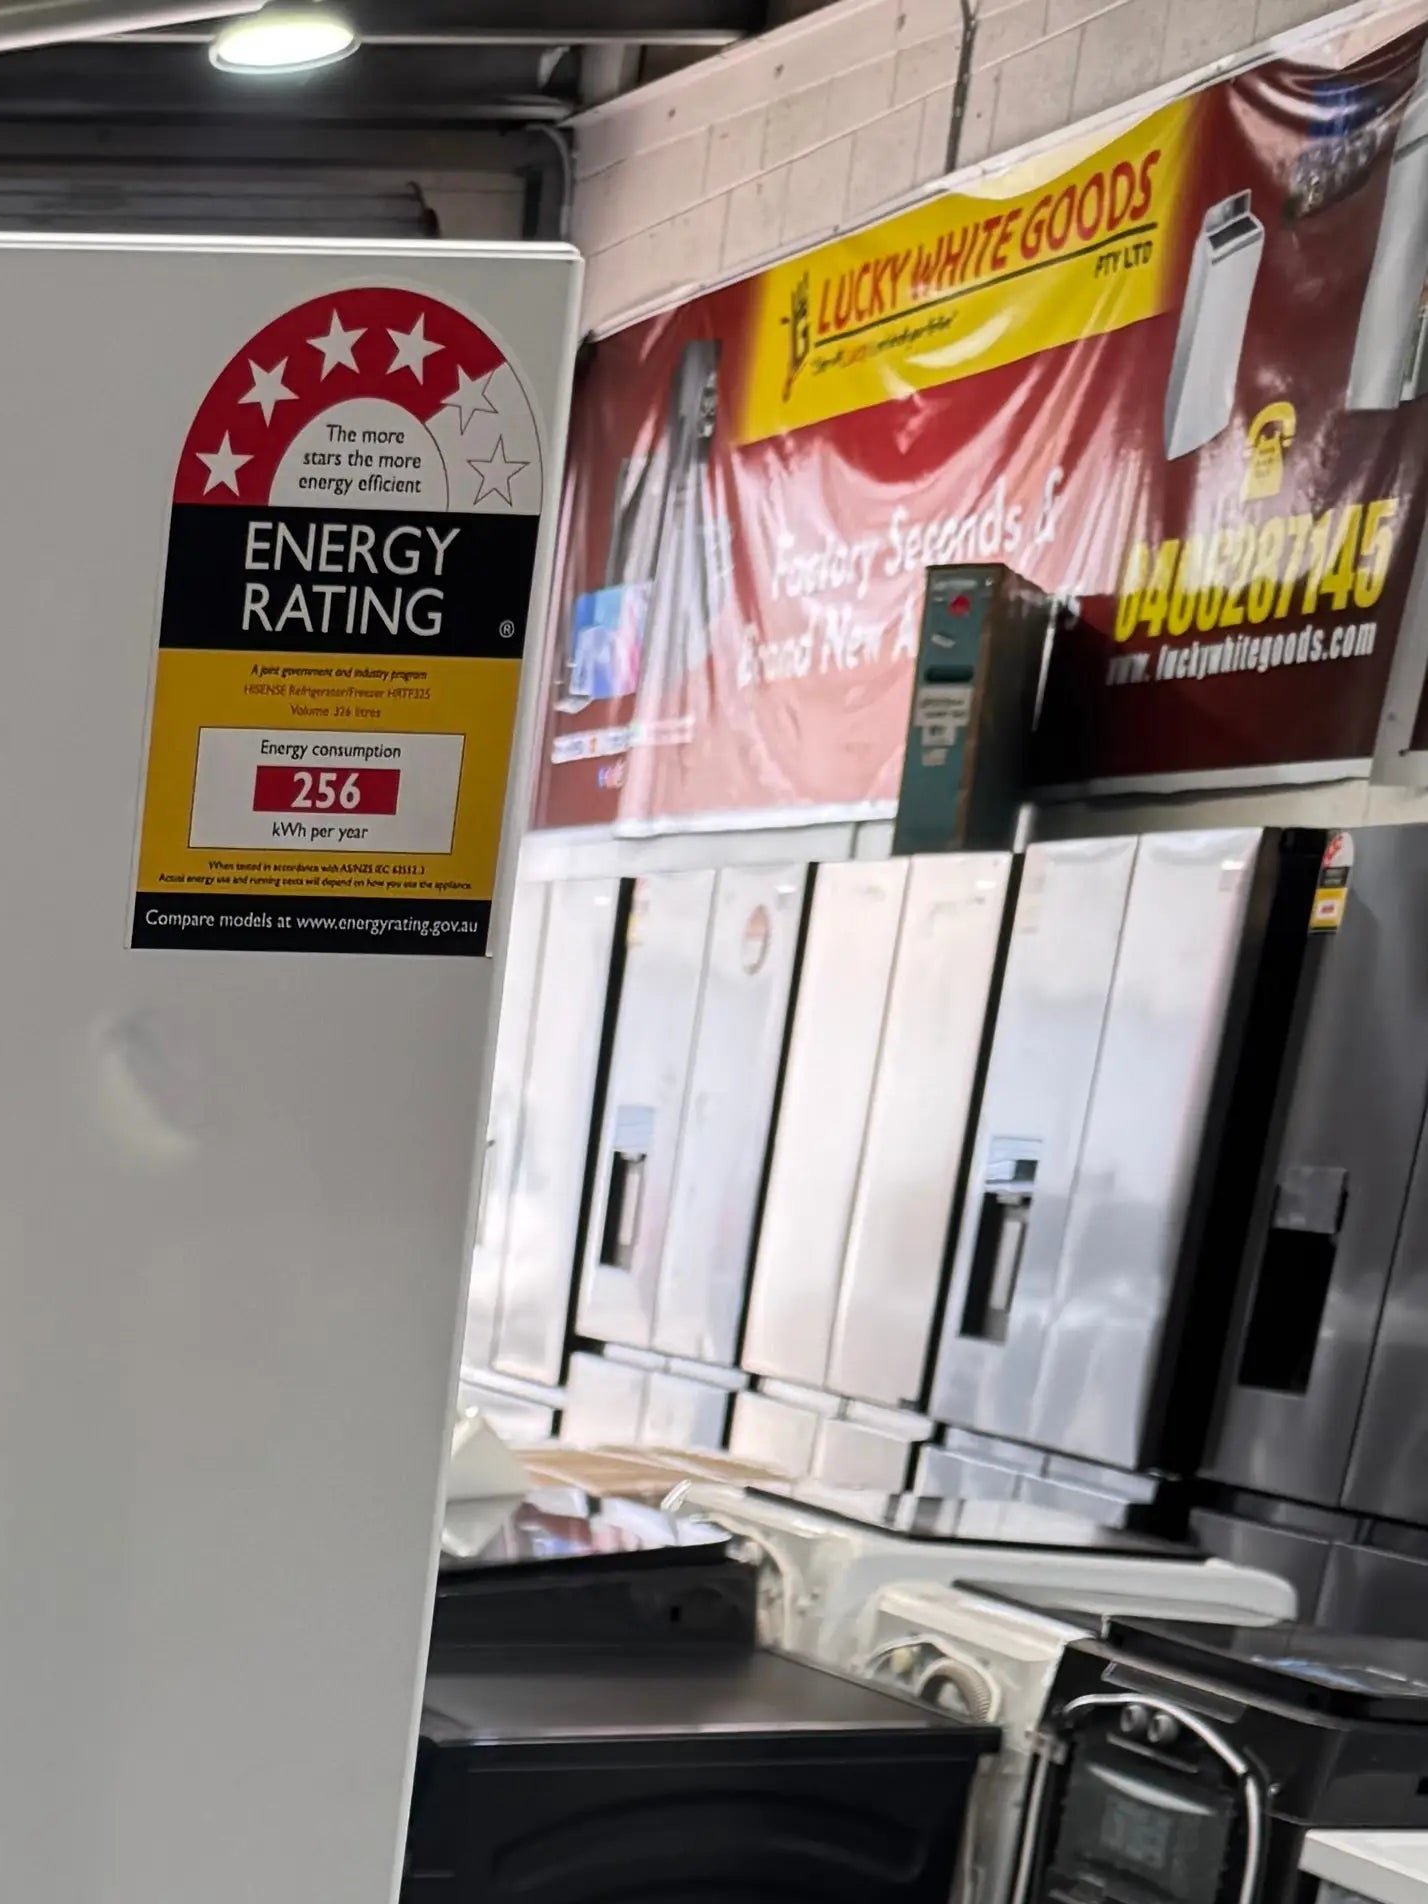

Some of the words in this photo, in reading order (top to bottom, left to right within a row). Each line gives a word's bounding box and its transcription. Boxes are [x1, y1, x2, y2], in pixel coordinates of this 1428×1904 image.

[817, 249, 913, 334] LUCKY
[911, 207, 1023, 300] WHITE
[1020, 149, 1162, 260] GOODS
[1093, 248, 1120, 278] PTY
[1121, 240, 1154, 271] LTD
[326, 423, 357, 443] The
[362, 430, 405, 445] more
[303, 451, 342, 467] stars
[347, 449, 374, 468] the
[378, 454, 422, 470] more
[298, 475, 353, 497] energy
[358, 473, 422, 494] efficient
[882, 473, 1023, 576] Seconds
[244, 520, 461, 576] ENERGY
[242, 582, 445, 637] RATING
[1155, 621, 1378, 682] luckywhitegoods.com
[335, 667, 353, 679] and
[290, 704, 330, 718] Volume
[260, 739, 308, 760] Energy
[312, 743, 403, 762] consumption
[290, 771, 362, 810] 256
[272, 820, 307, 838] kWh
[311, 825, 335, 842] per
[338, 826, 369, 843] year
[145, 909, 216, 931] Compare
[219, 911, 273, 929] models
[277, 915, 293, 929] at
[296, 916, 479, 937] www.energyrating.gov.au
